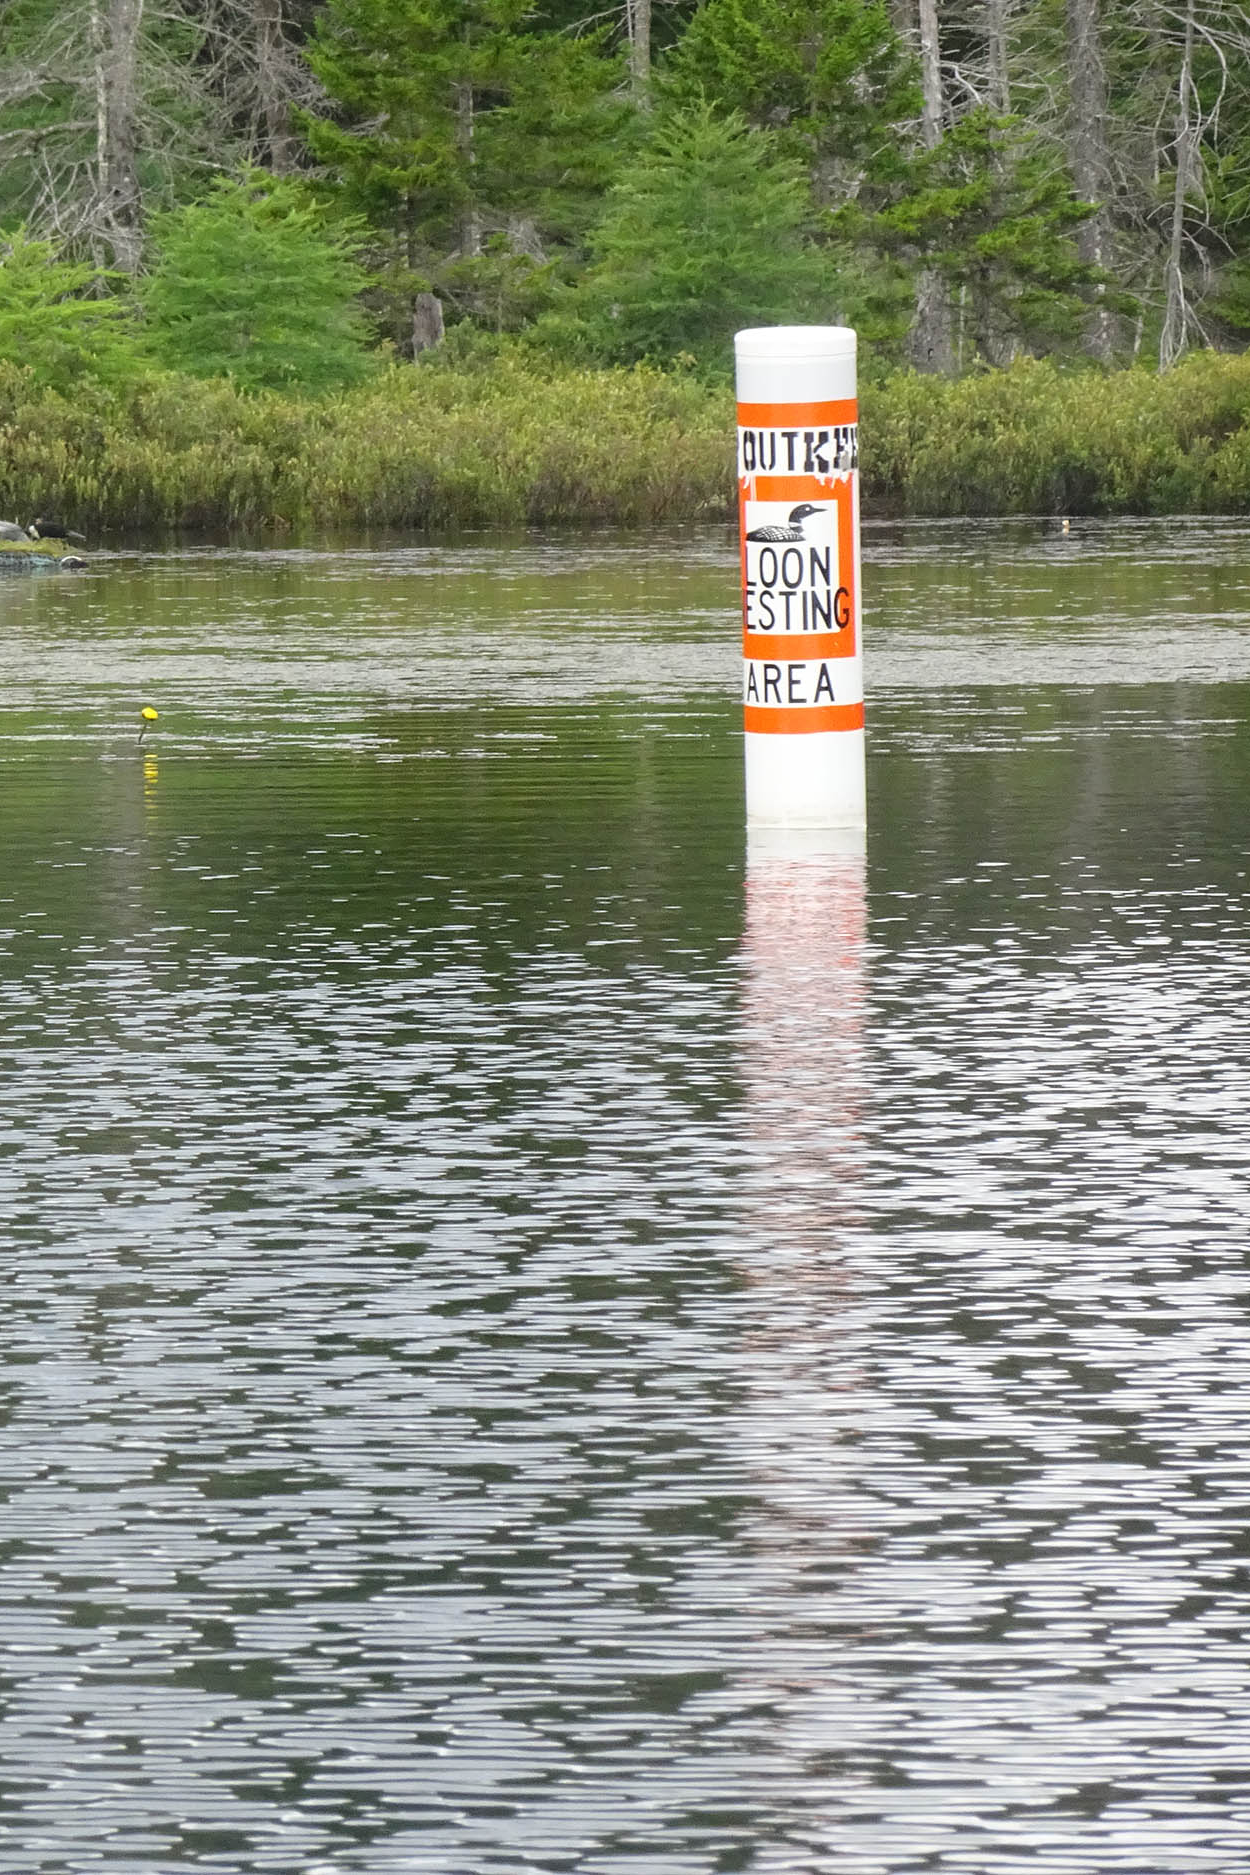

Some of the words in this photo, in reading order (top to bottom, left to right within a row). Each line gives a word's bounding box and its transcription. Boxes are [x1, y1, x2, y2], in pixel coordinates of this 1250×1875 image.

[743, 430, 799, 471] OUT
[745, 546, 830, 588] LOON
[744, 587, 849, 631] ESTING
[747, 662, 835, 703] AREA
